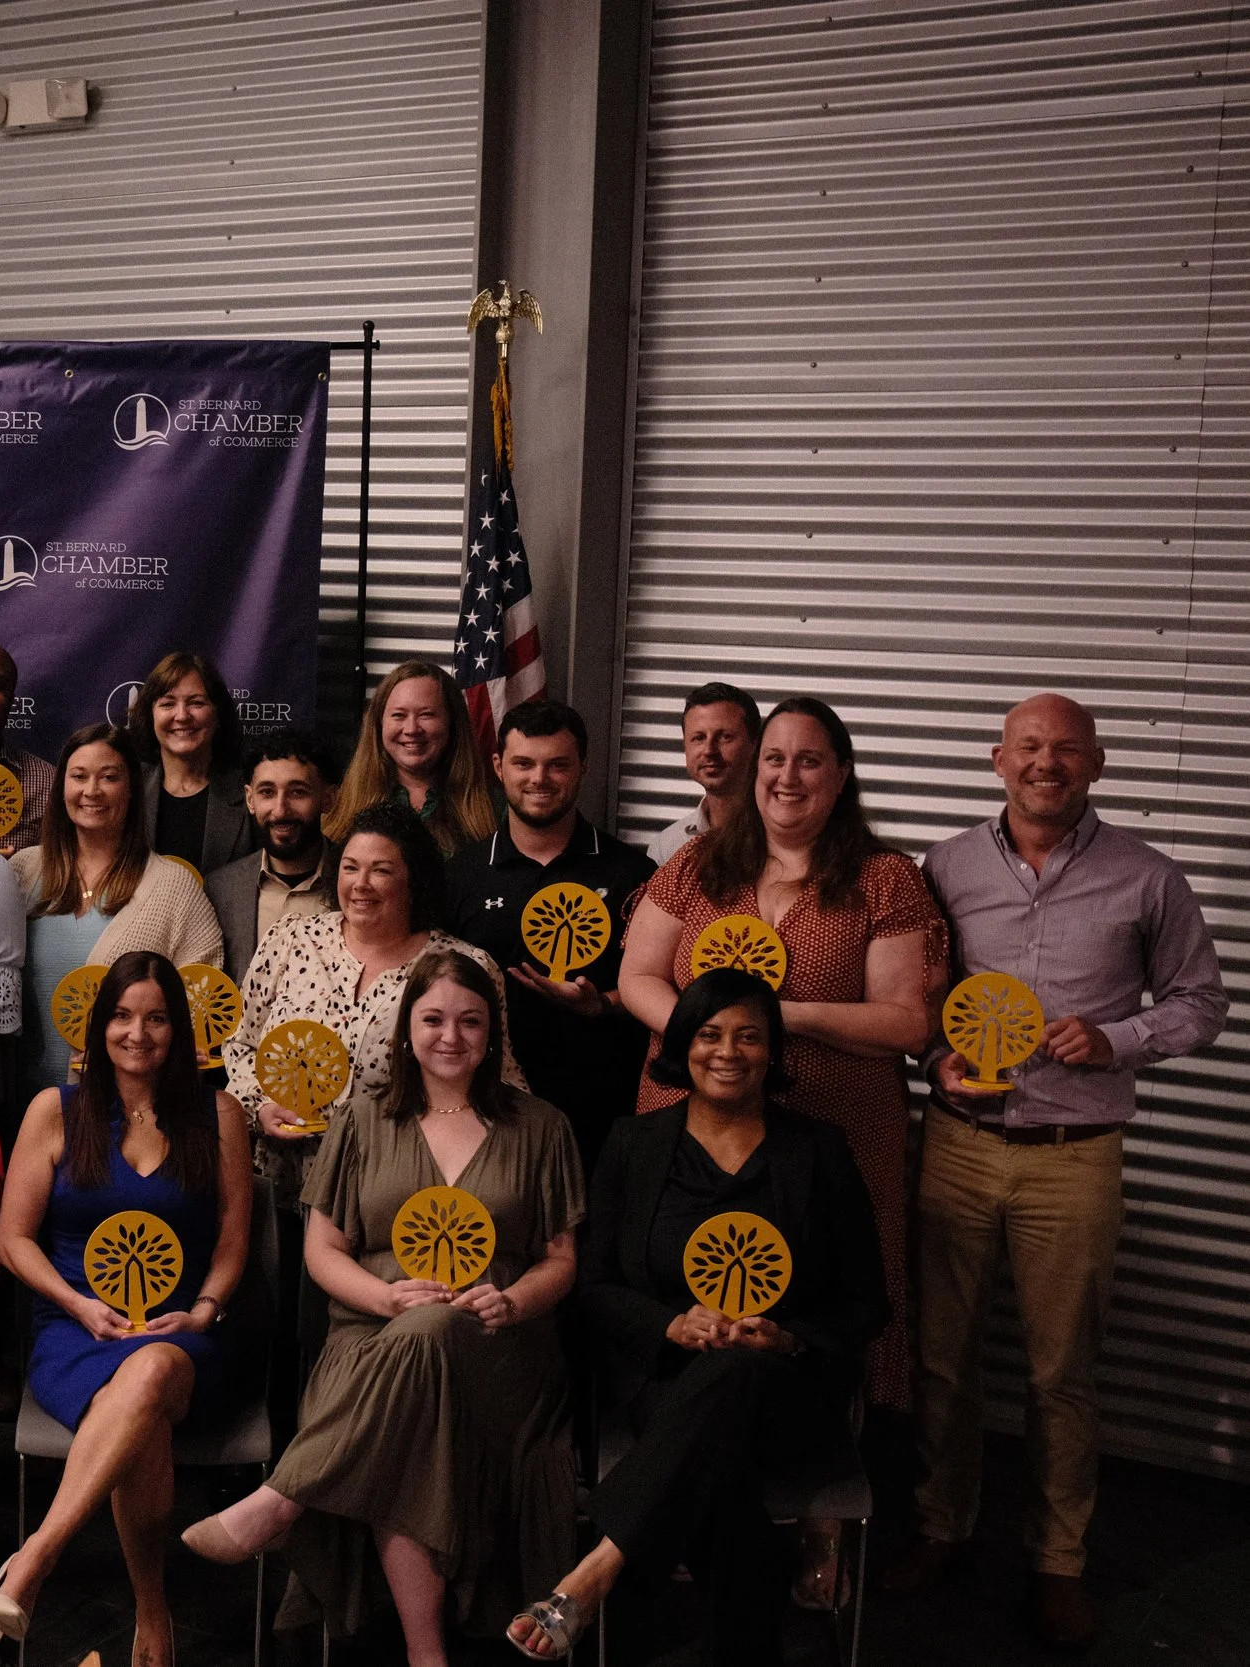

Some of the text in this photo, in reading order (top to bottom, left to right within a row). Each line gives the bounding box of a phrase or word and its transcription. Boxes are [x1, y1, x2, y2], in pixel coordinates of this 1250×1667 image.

[178, 400, 262, 411] ST. BERNARD
[174, 413, 304, 433] CHAMBER
[209, 436, 299, 448] of COMMERCE
[46, 542, 127, 553] ST. BERNARD
[41, 555, 169, 576] CHAMBER
[75, 577, 165, 590] of COMMERCE
